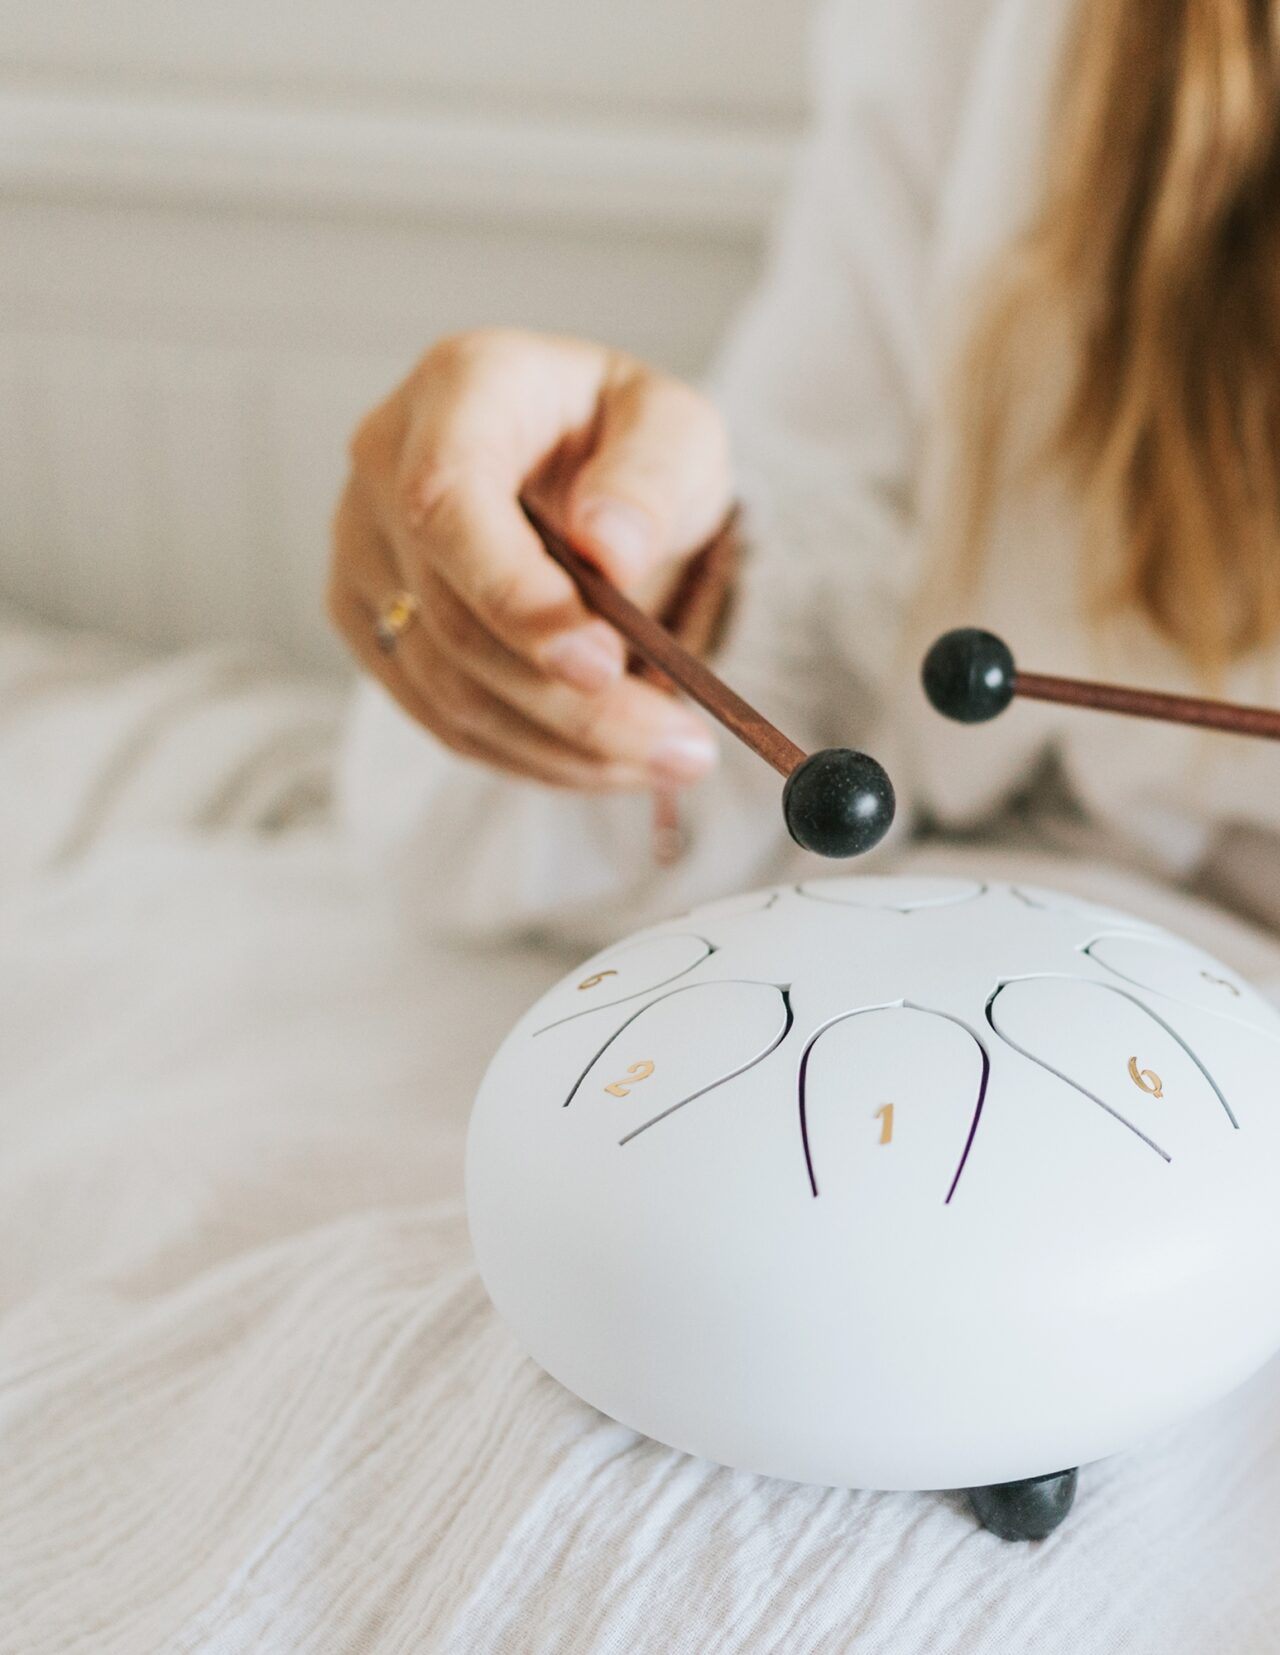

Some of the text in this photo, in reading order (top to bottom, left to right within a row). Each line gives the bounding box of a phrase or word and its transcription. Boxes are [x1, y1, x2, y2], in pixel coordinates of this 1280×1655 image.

[604, 1059, 655, 1098] 2
[1128, 1055, 1164, 1099] 6
[872, 1102, 894, 1145] 1
